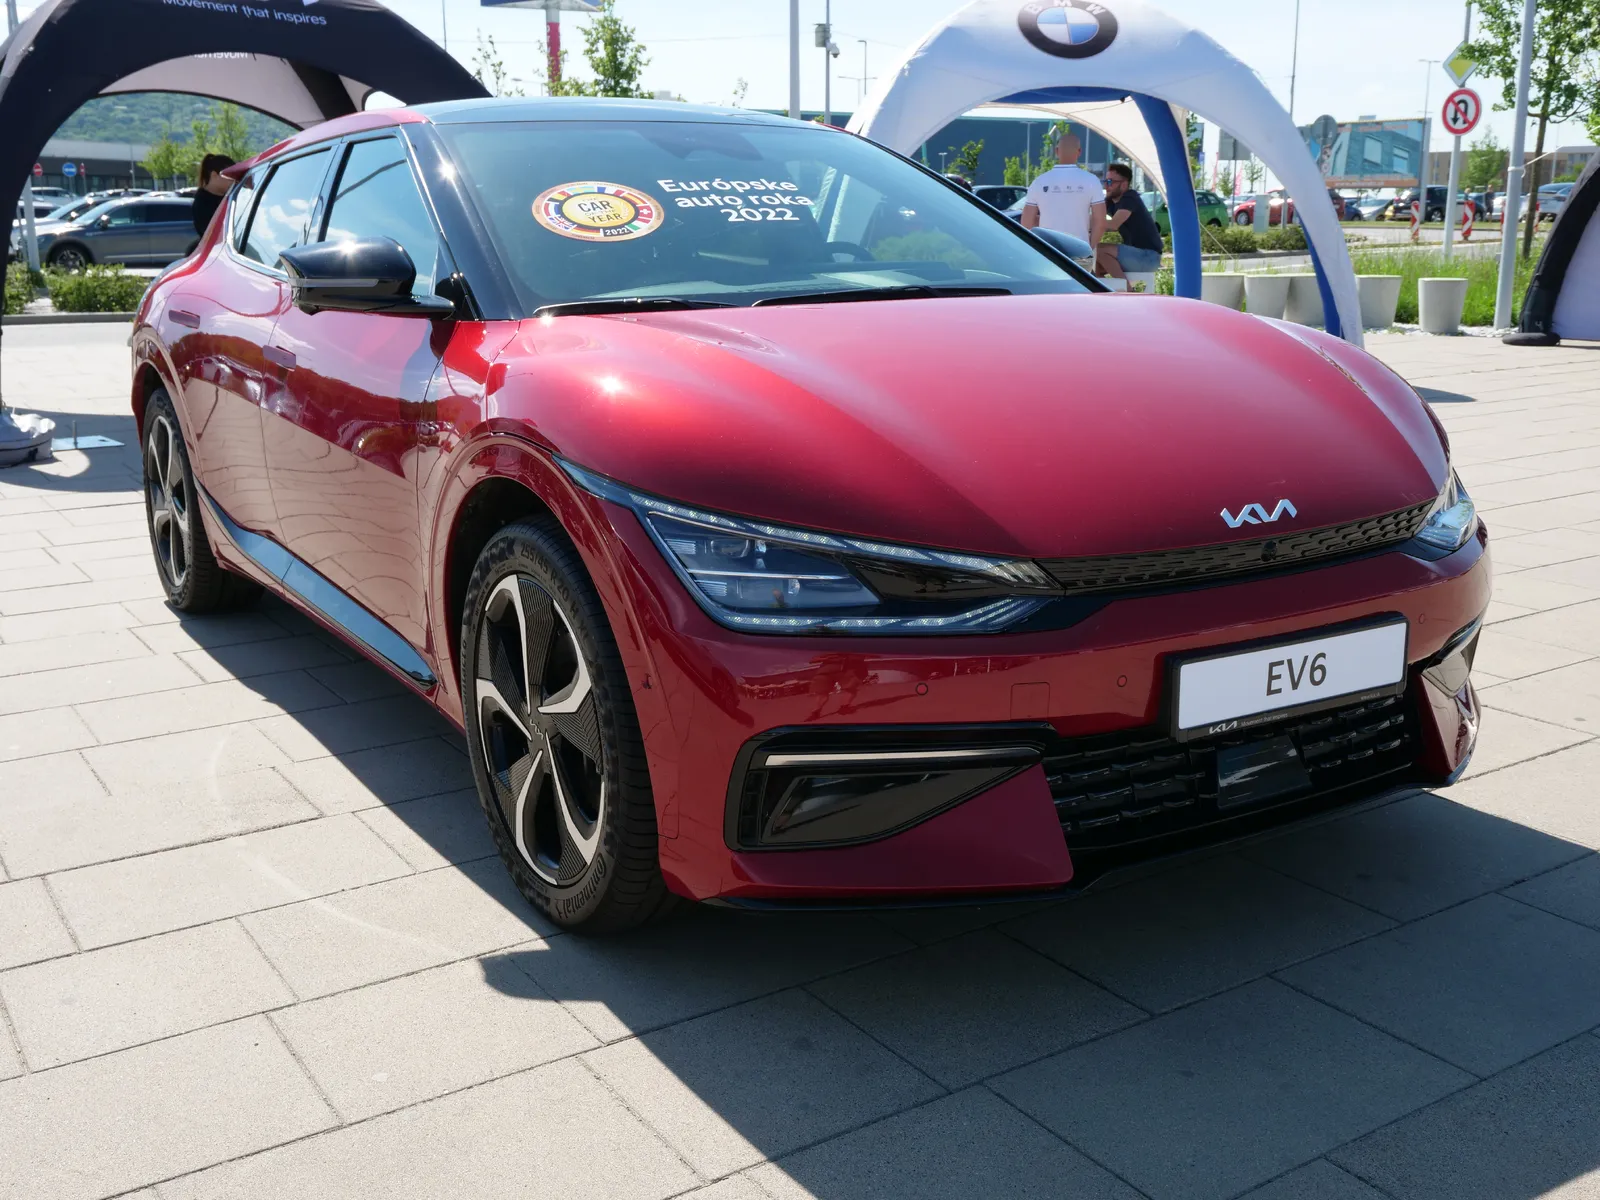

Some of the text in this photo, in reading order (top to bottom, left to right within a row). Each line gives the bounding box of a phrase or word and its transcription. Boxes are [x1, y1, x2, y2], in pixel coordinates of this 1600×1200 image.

[242, 5, 270, 18] that
[274, 10, 327, 25] inspires
[657, 178, 799, 193] Európske
[578, 200, 614, 212] CAR
[674, 192, 815, 208] auto roka
[588, 212, 623, 224] YEAR
[720, 207, 800, 222] 2022
[604, 226, 631, 236] 2022
[520, 541, 549, 575] 255/45
[1266, 652, 1327, 697] EV6
[563, 852, 607, 919] Continental
